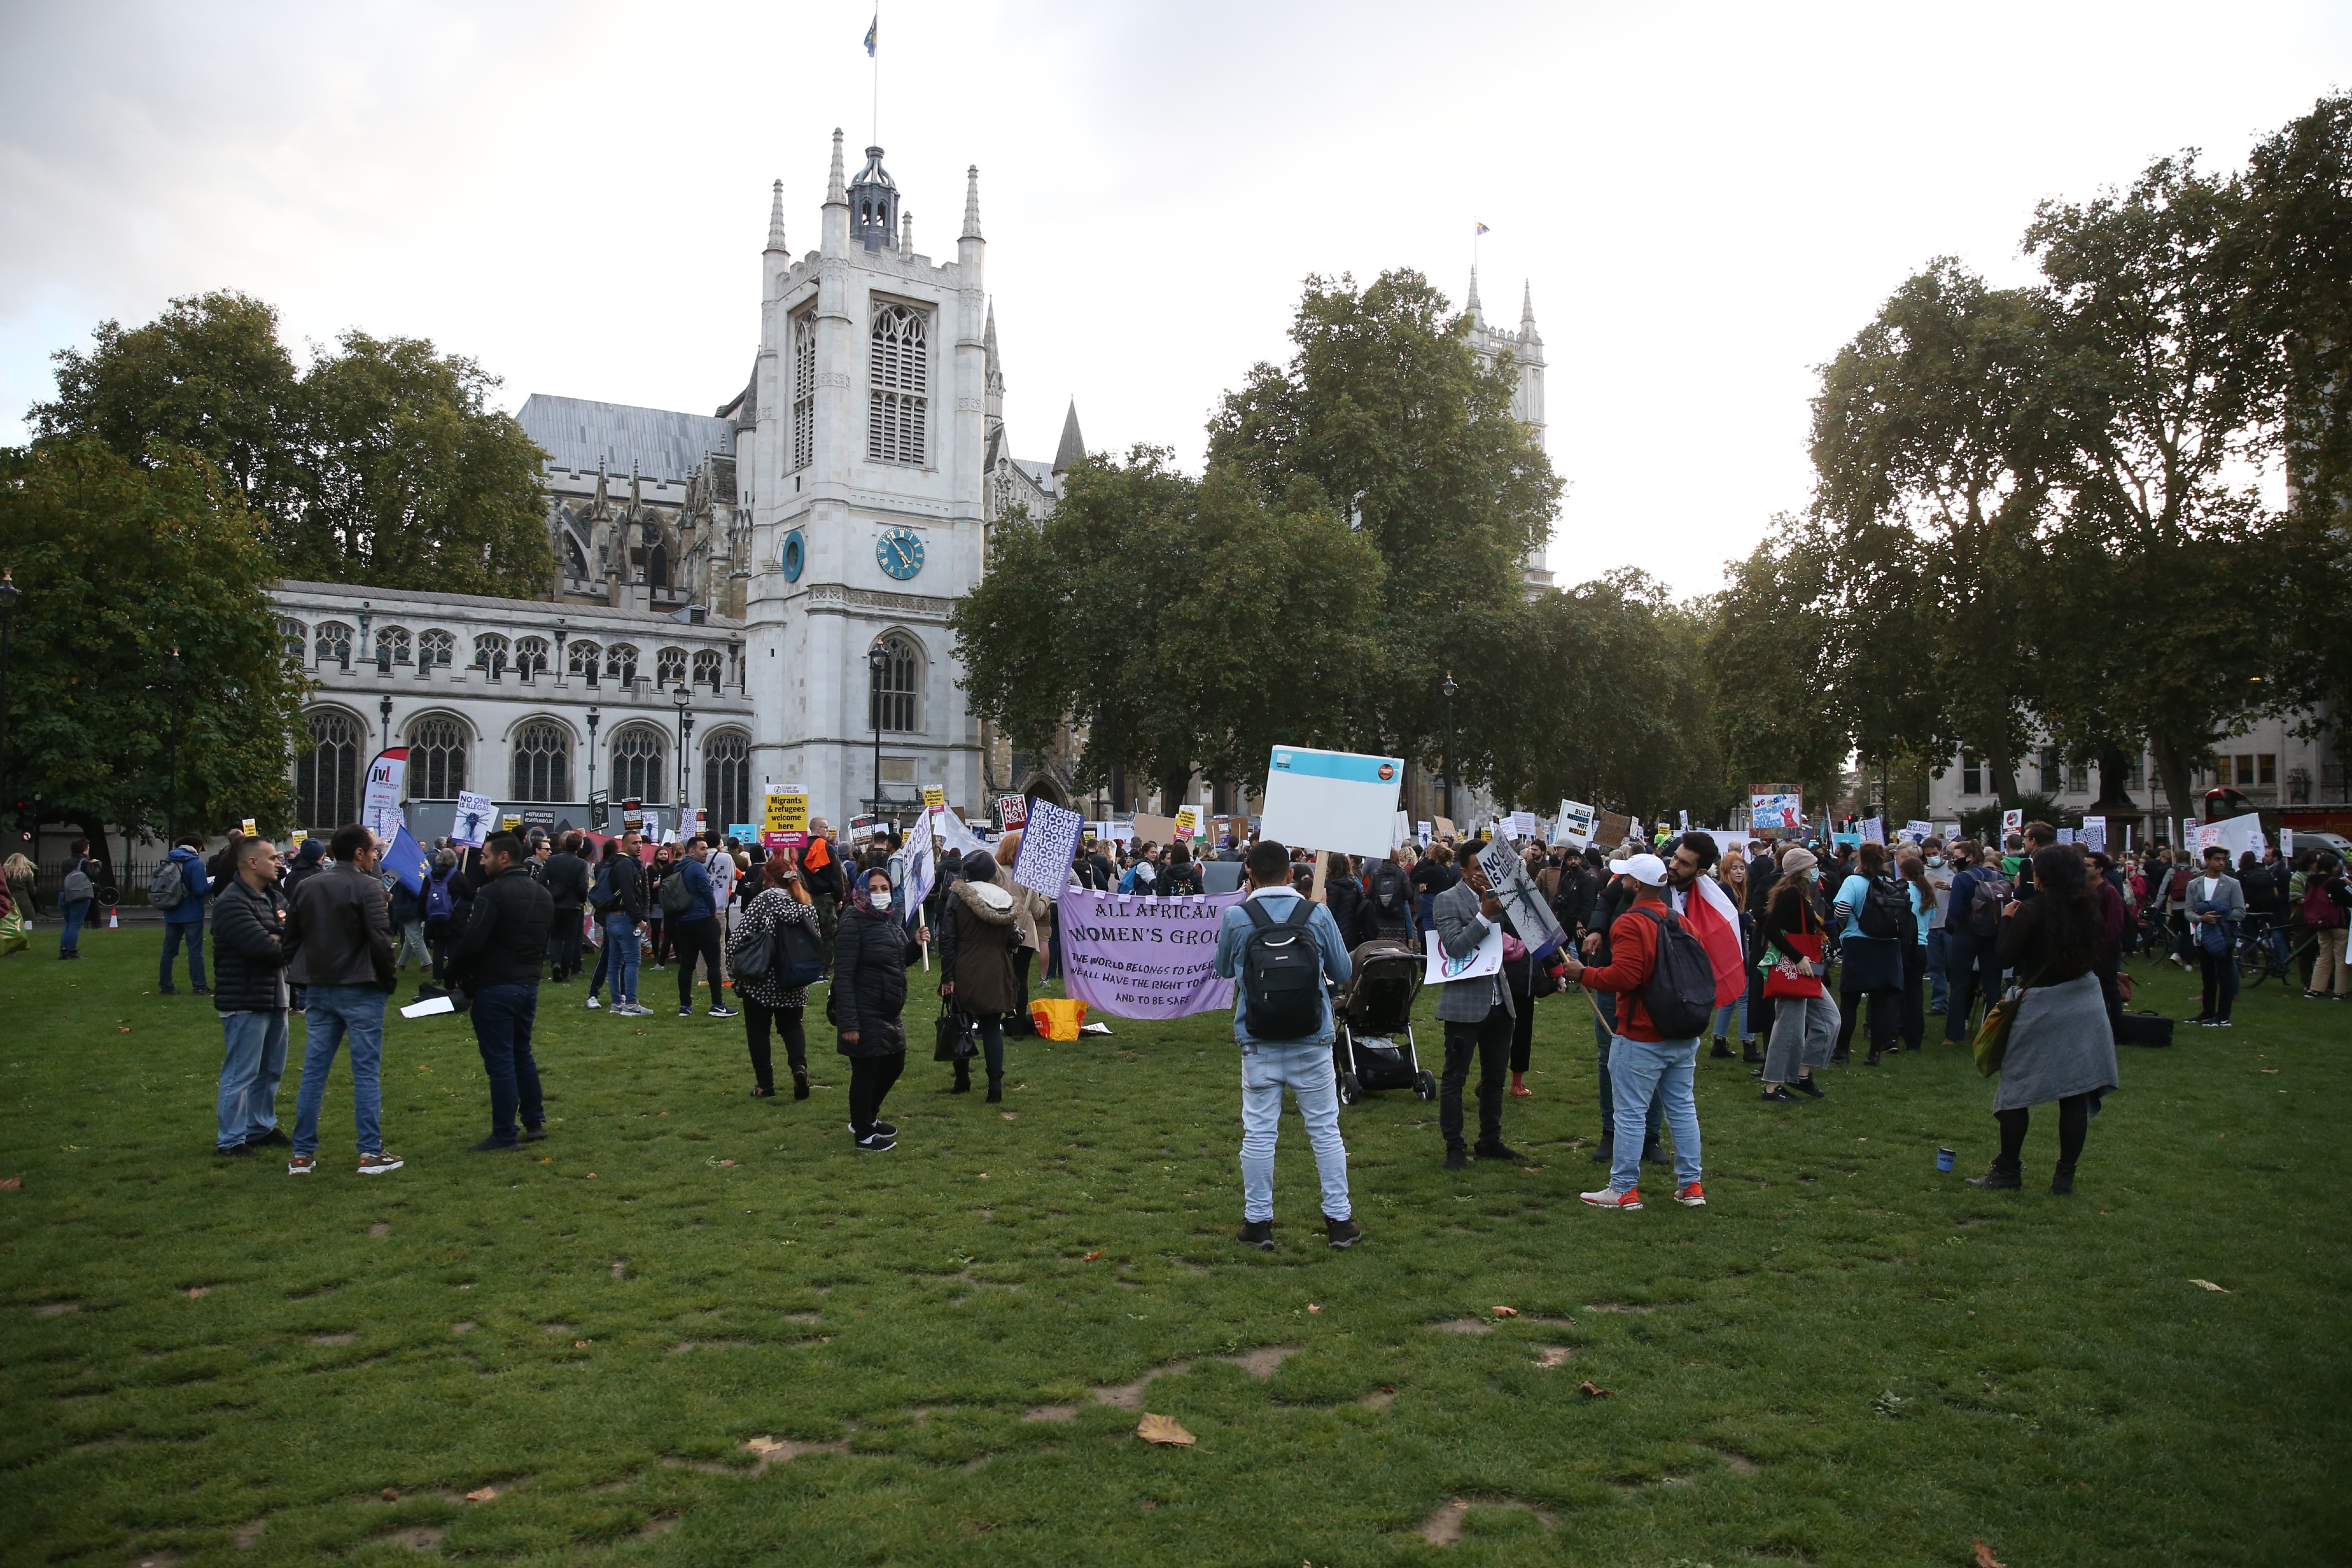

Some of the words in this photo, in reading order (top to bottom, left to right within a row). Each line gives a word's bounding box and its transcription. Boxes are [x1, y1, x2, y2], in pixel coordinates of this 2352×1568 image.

[371, 766, 391, 782] jvl
[466, 802, 490, 812] ILLEGAL
[473, 797, 490, 806] ONE
[771, 796, 802, 806] Migrants
[774, 805, 805, 814] refugees
[1002, 797, 1022, 807] STOP
[1004, 803, 1023, 813] WAR
[1005, 809, 1024, 821] NOT
[1032, 807, 1080, 831] WELCOME
[1035, 801, 1081, 822] REFUGEES
[1567, 813, 1589, 824] BRIDGES
[1575, 809, 1591, 818] BUILD
[853, 824, 872, 833] REFUGEES
[853, 831, 873, 839] WELCOME
[1027, 824, 1075, 848] WELCOME
[1030, 816, 1076, 839] REFUGEES
[1569, 826, 1587, 837] WALLS
[1750, 828, 1801, 838] WELCOME
[904, 841, 912, 861] NO
[913, 812, 928, 842] ONE
[908, 824, 930, 862] ILLEGAL
[1025, 833, 1071, 856] REFUGEES
[1023, 840, 1070, 864] WELCOME
[1019, 857, 1065, 880] WELCOME
[1020, 850, 1066, 872] REFUGEES
[1482, 852, 1501, 876] NO
[1014, 873, 1060, 897] WELCOME
[1016, 865, 1061, 888] REFUGEES
[1490, 872, 1502, 888] IS
[1095, 903, 1129, 918] ALL
[1135, 903, 1218, 920] AFRICAN
[1069, 924, 1163, 943] WOMEN'S
[1071, 953, 1088, 963] THE
[1090, 957, 1124, 970] WORLD
[1126, 962, 1170, 976] BELONGS
[1172, 966, 1185, 976] TO
[1071, 967, 1083, 976] WE
[1084, 970, 1100, 979] ALL
[1102, 973, 1129, 986] HAVE
[1131, 979, 1149, 989] THE
[1152, 981, 1185, 990] RIGHT
[1187, 979, 1199, 989] TO
[1115, 992, 1134, 1003] AND
[1138, 996, 1151, 1005] TO
[1152, 997, 1165, 1005] BE
[1168, 995, 1191, 1006] SAFE
